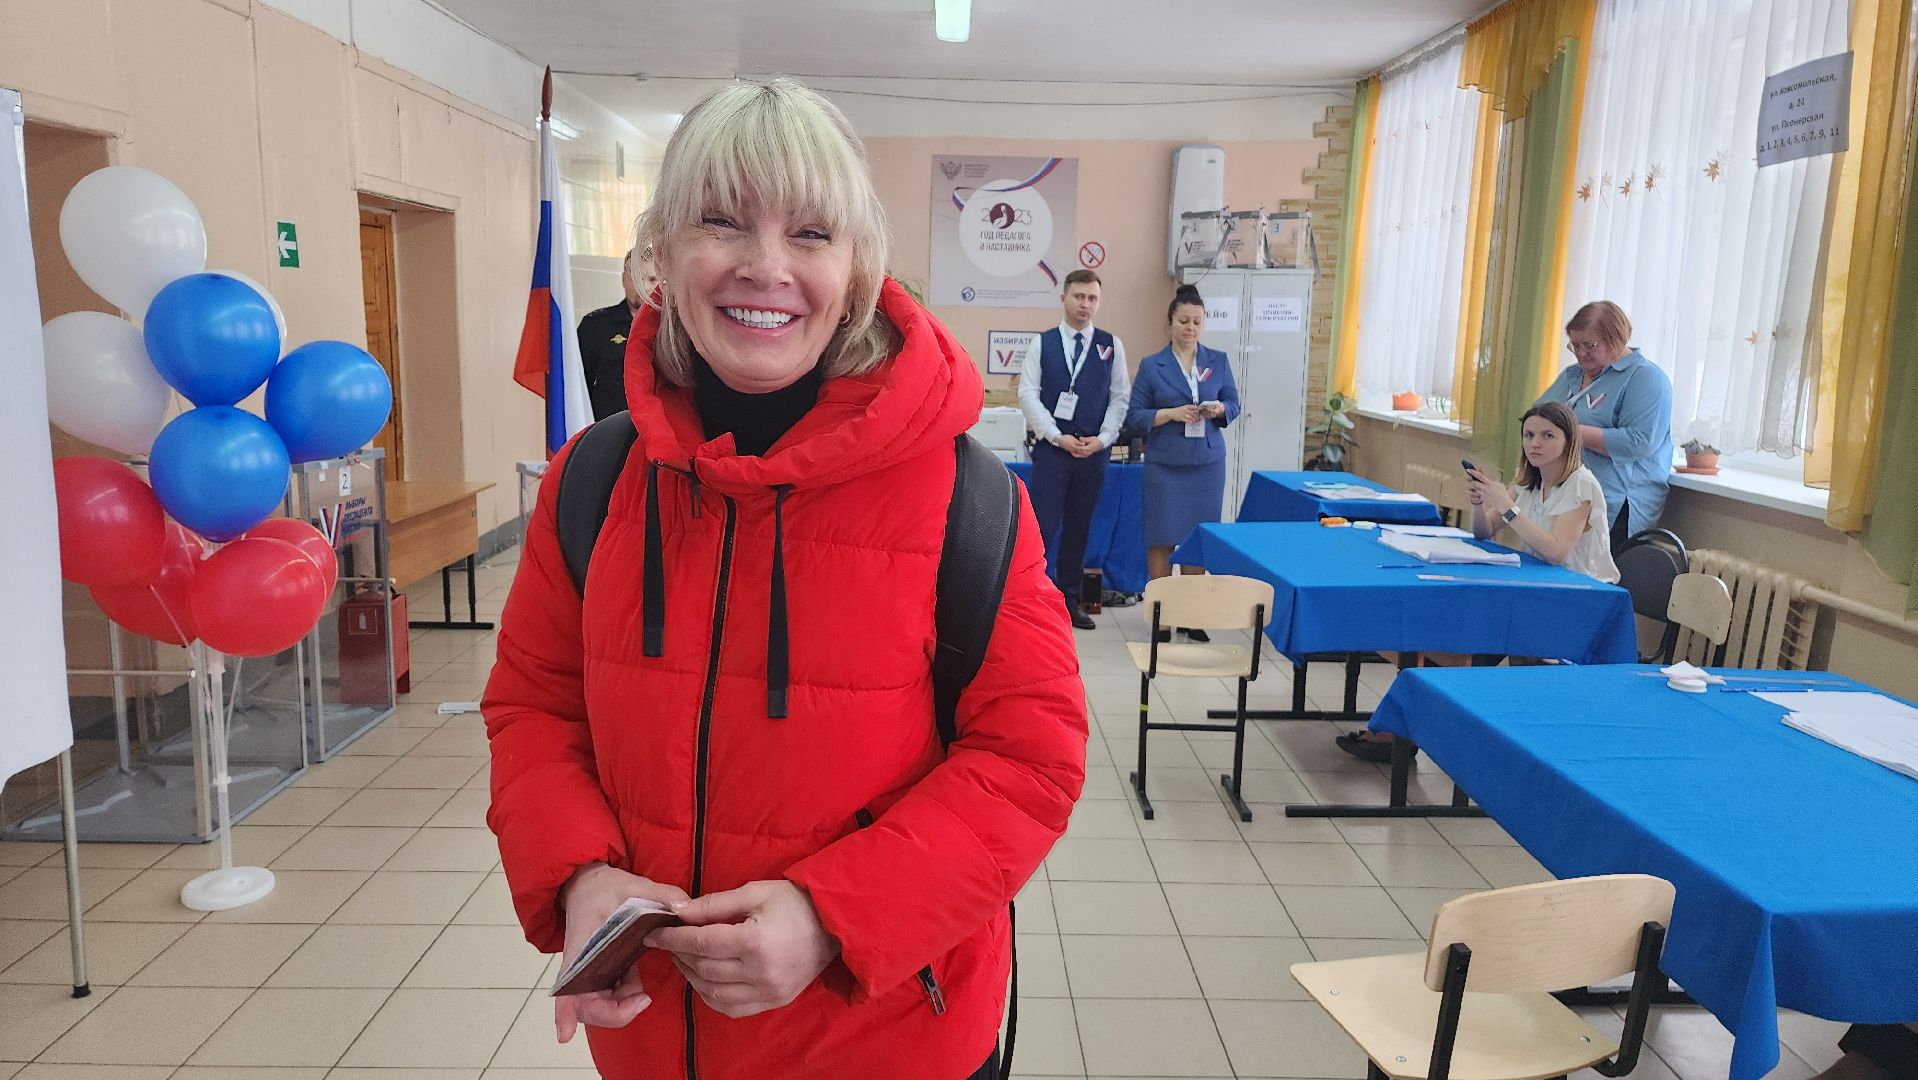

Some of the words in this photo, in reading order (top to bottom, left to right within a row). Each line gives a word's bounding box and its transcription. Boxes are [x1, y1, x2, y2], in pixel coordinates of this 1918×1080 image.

[980, 231, 994, 240] ГОД
[995, 231, 1031, 240] ПЕДАГОГА
[985, 243, 1031, 252] НАСТАВНИКА
[1206, 309, 1228, 318] ЕЙФ
[342, 473, 348, 489] 2
